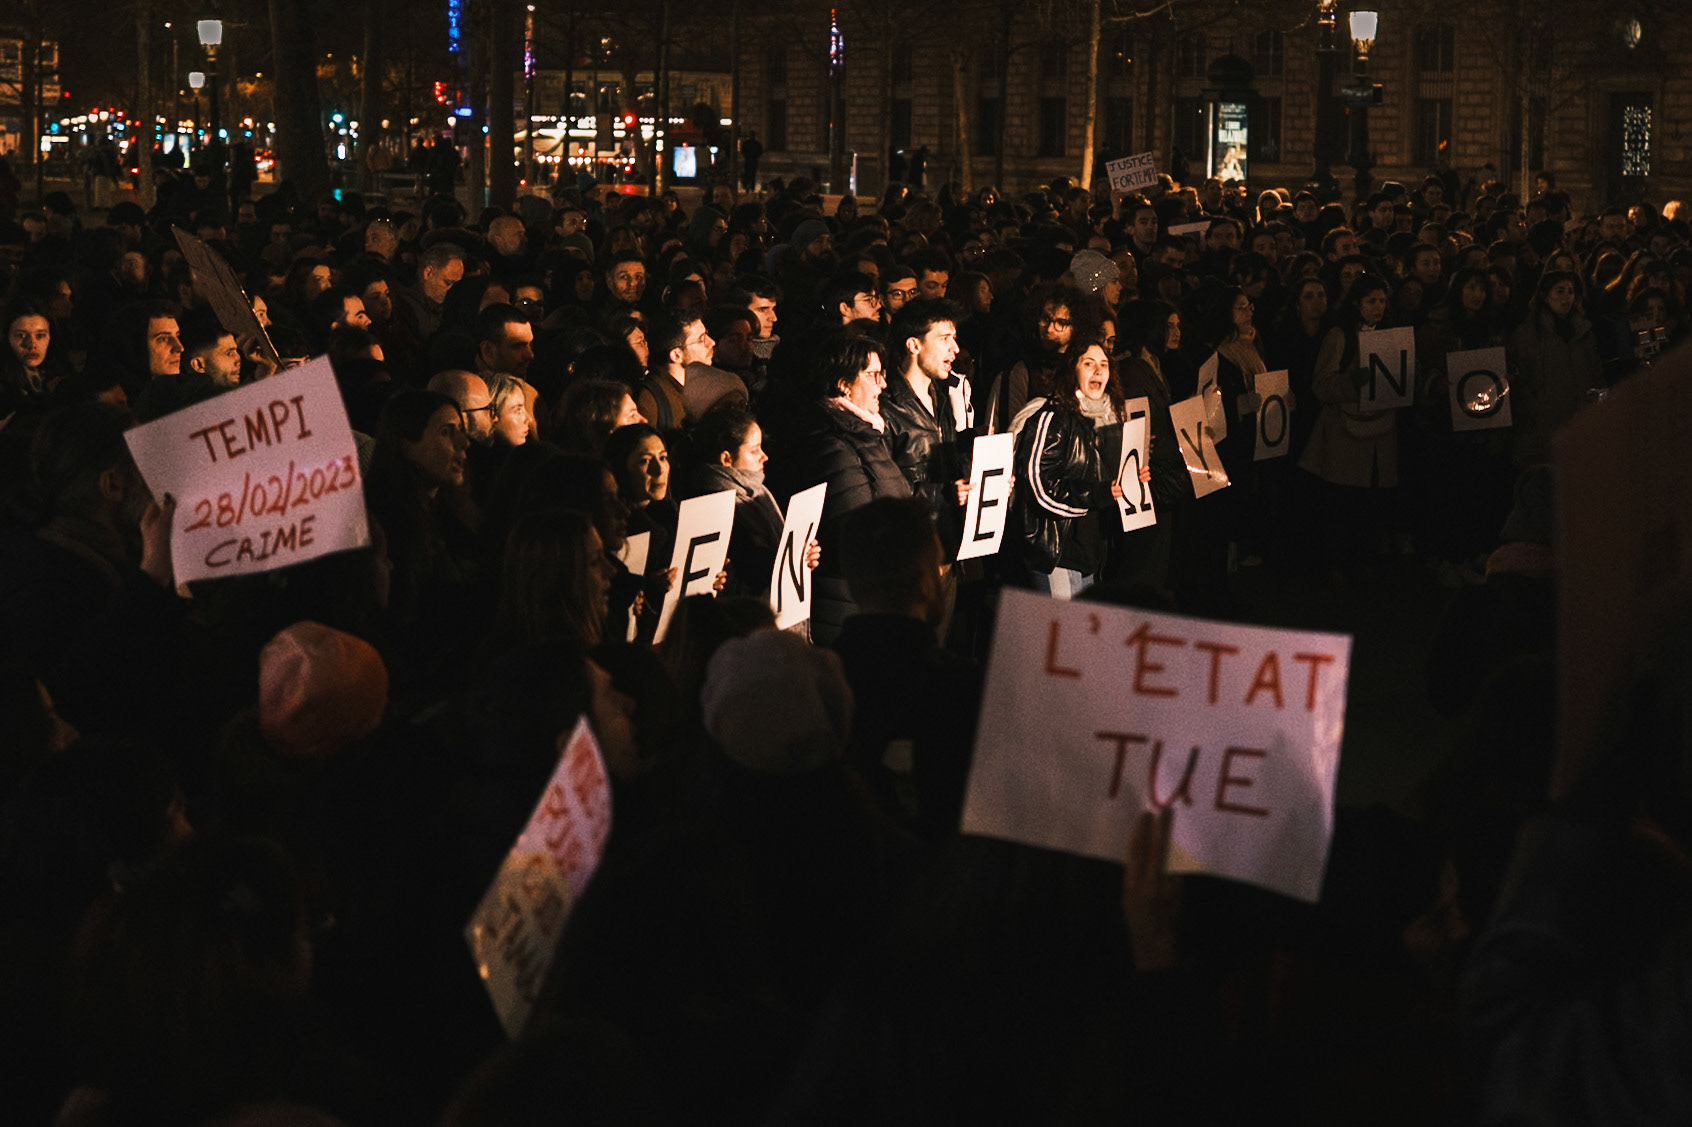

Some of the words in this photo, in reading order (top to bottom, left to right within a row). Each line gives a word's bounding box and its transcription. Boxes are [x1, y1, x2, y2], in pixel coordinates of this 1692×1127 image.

[1109, 154, 1153, 172] JUSTICE
[189, 395, 313, 462] TEMPI
[184, 455, 356, 533] 28/02/2023
[204, 514, 317, 568] CRIME
[1093, 728, 1271, 818] TUE
